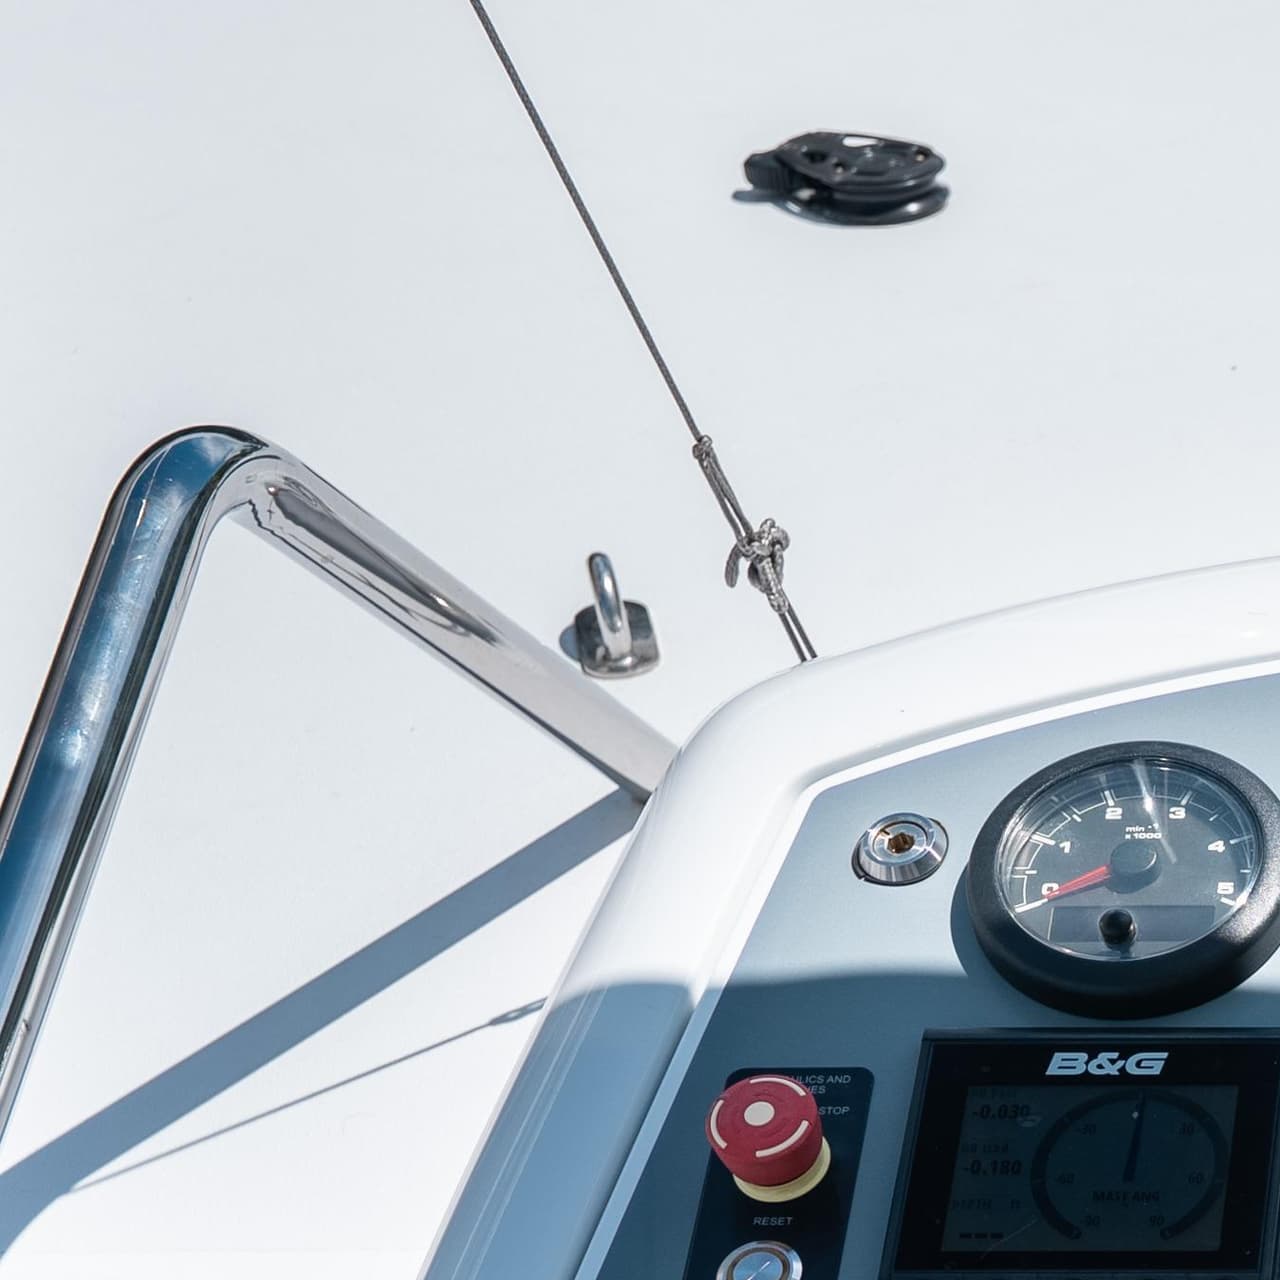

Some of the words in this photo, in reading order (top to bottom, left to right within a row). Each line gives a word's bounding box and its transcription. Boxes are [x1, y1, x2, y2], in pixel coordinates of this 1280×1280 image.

[1105, 807, 1123, 820] 2
[1168, 806, 1186, 820] 3
[1059, 841, 1072, 854] 1
[1208, 840, 1226, 852] 4
[1041, 883, 1060, 897] 0
[1217, 882, 1235, 894] 5
[1045, 1052, 1170, 1076] B&G
[826, 1074, 851, 1084] AND
[818, 1106, 850, 1116] STOP
[962, 1160, 1023, 1176] -0.180
[753, 1217, 794, 1226] RESET
